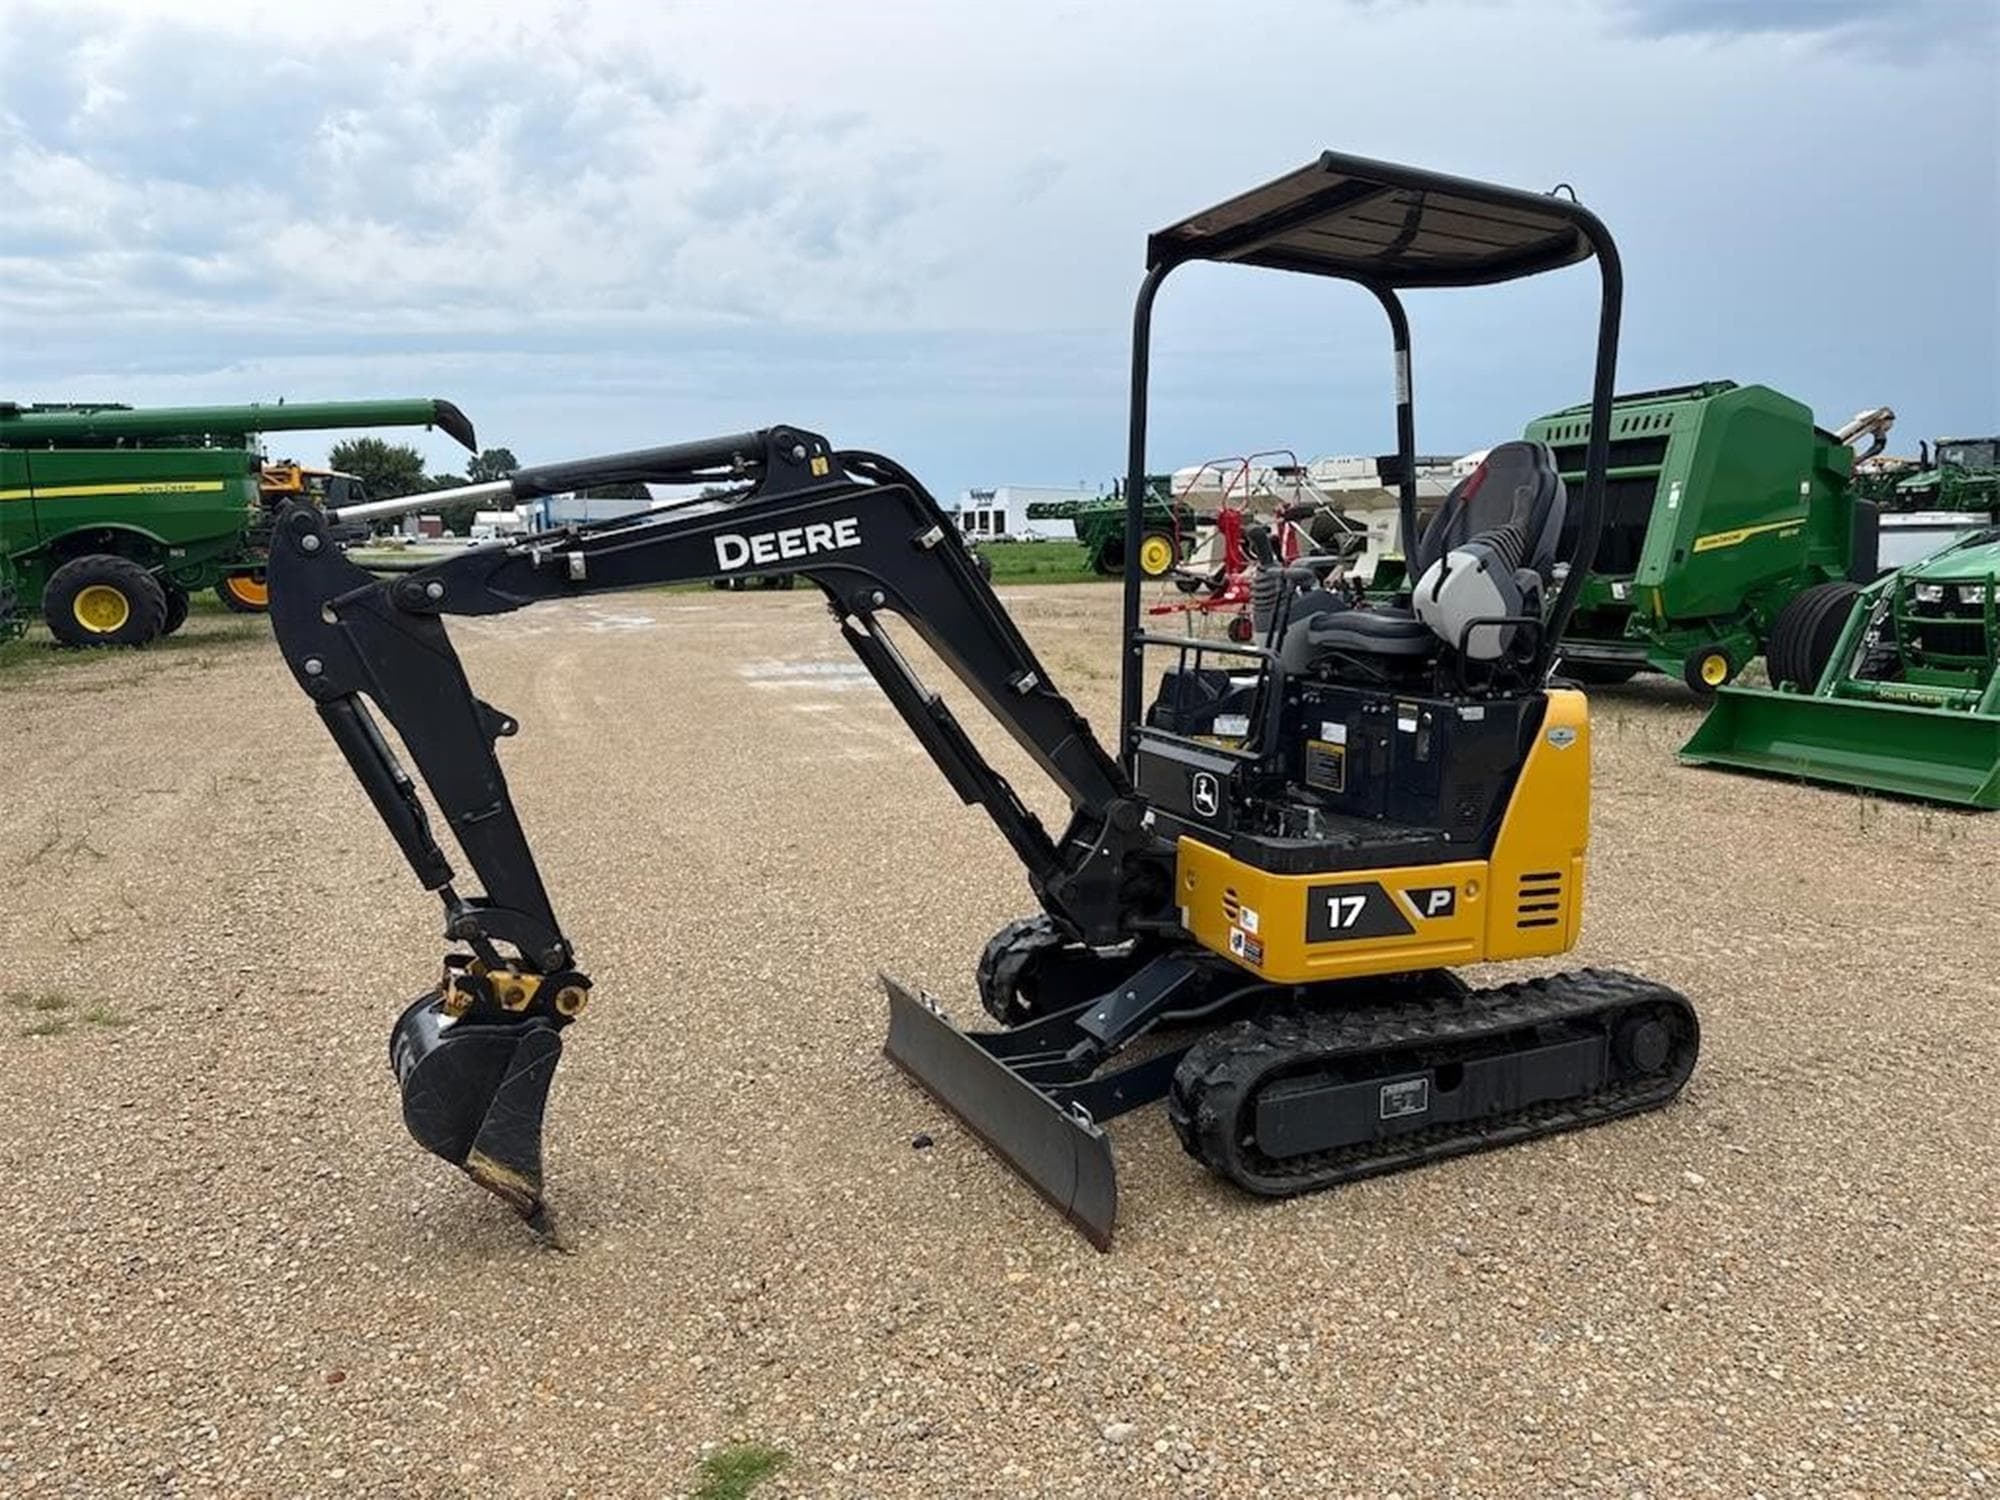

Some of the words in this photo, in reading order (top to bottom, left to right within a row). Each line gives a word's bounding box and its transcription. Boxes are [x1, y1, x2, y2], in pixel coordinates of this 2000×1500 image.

[714, 517, 861, 571] DEERE
[1327, 895, 1367, 929] 17
[1427, 890, 1451, 916] P
